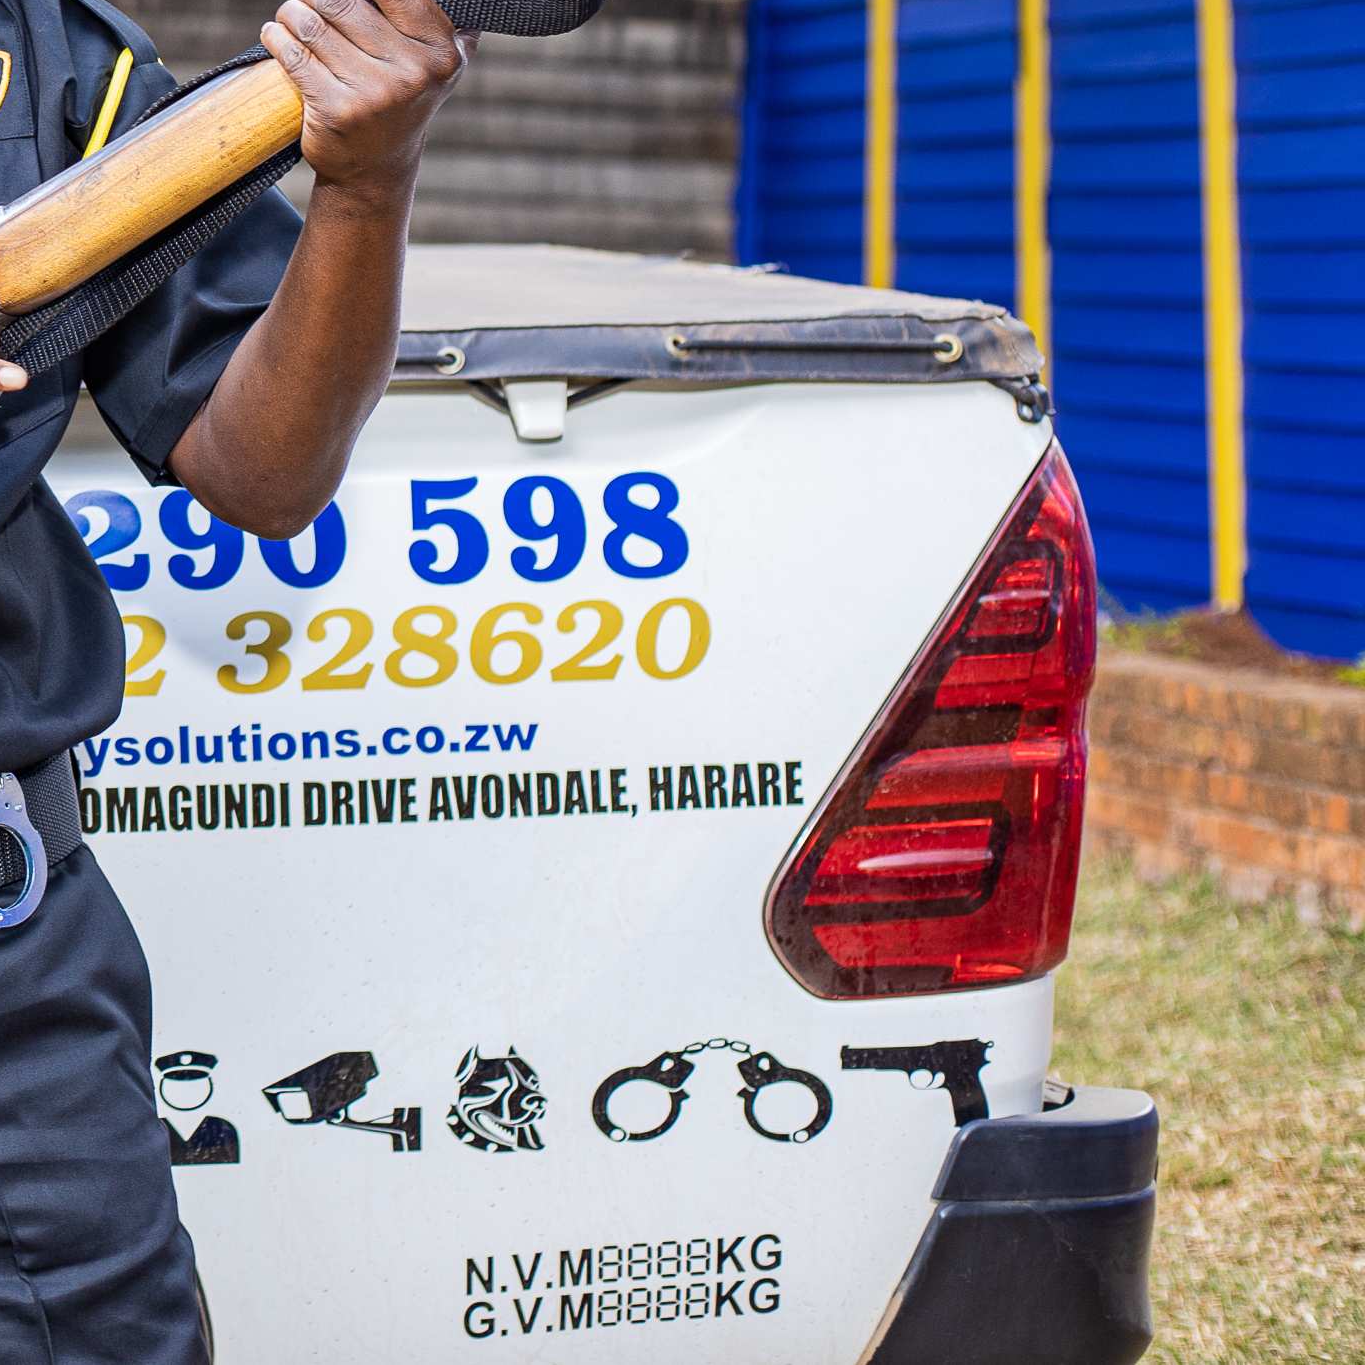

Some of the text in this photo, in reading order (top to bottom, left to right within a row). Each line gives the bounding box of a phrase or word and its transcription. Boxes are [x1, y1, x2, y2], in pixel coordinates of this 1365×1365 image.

[63, 472, 690, 591] 290 598
[217, 598, 712, 695] 328620
[74, 721, 539, 778] ysolutions.co.zw
[81, 761, 805, 835] OMAGUNDI DRIVE AVONDALE, HARARE
